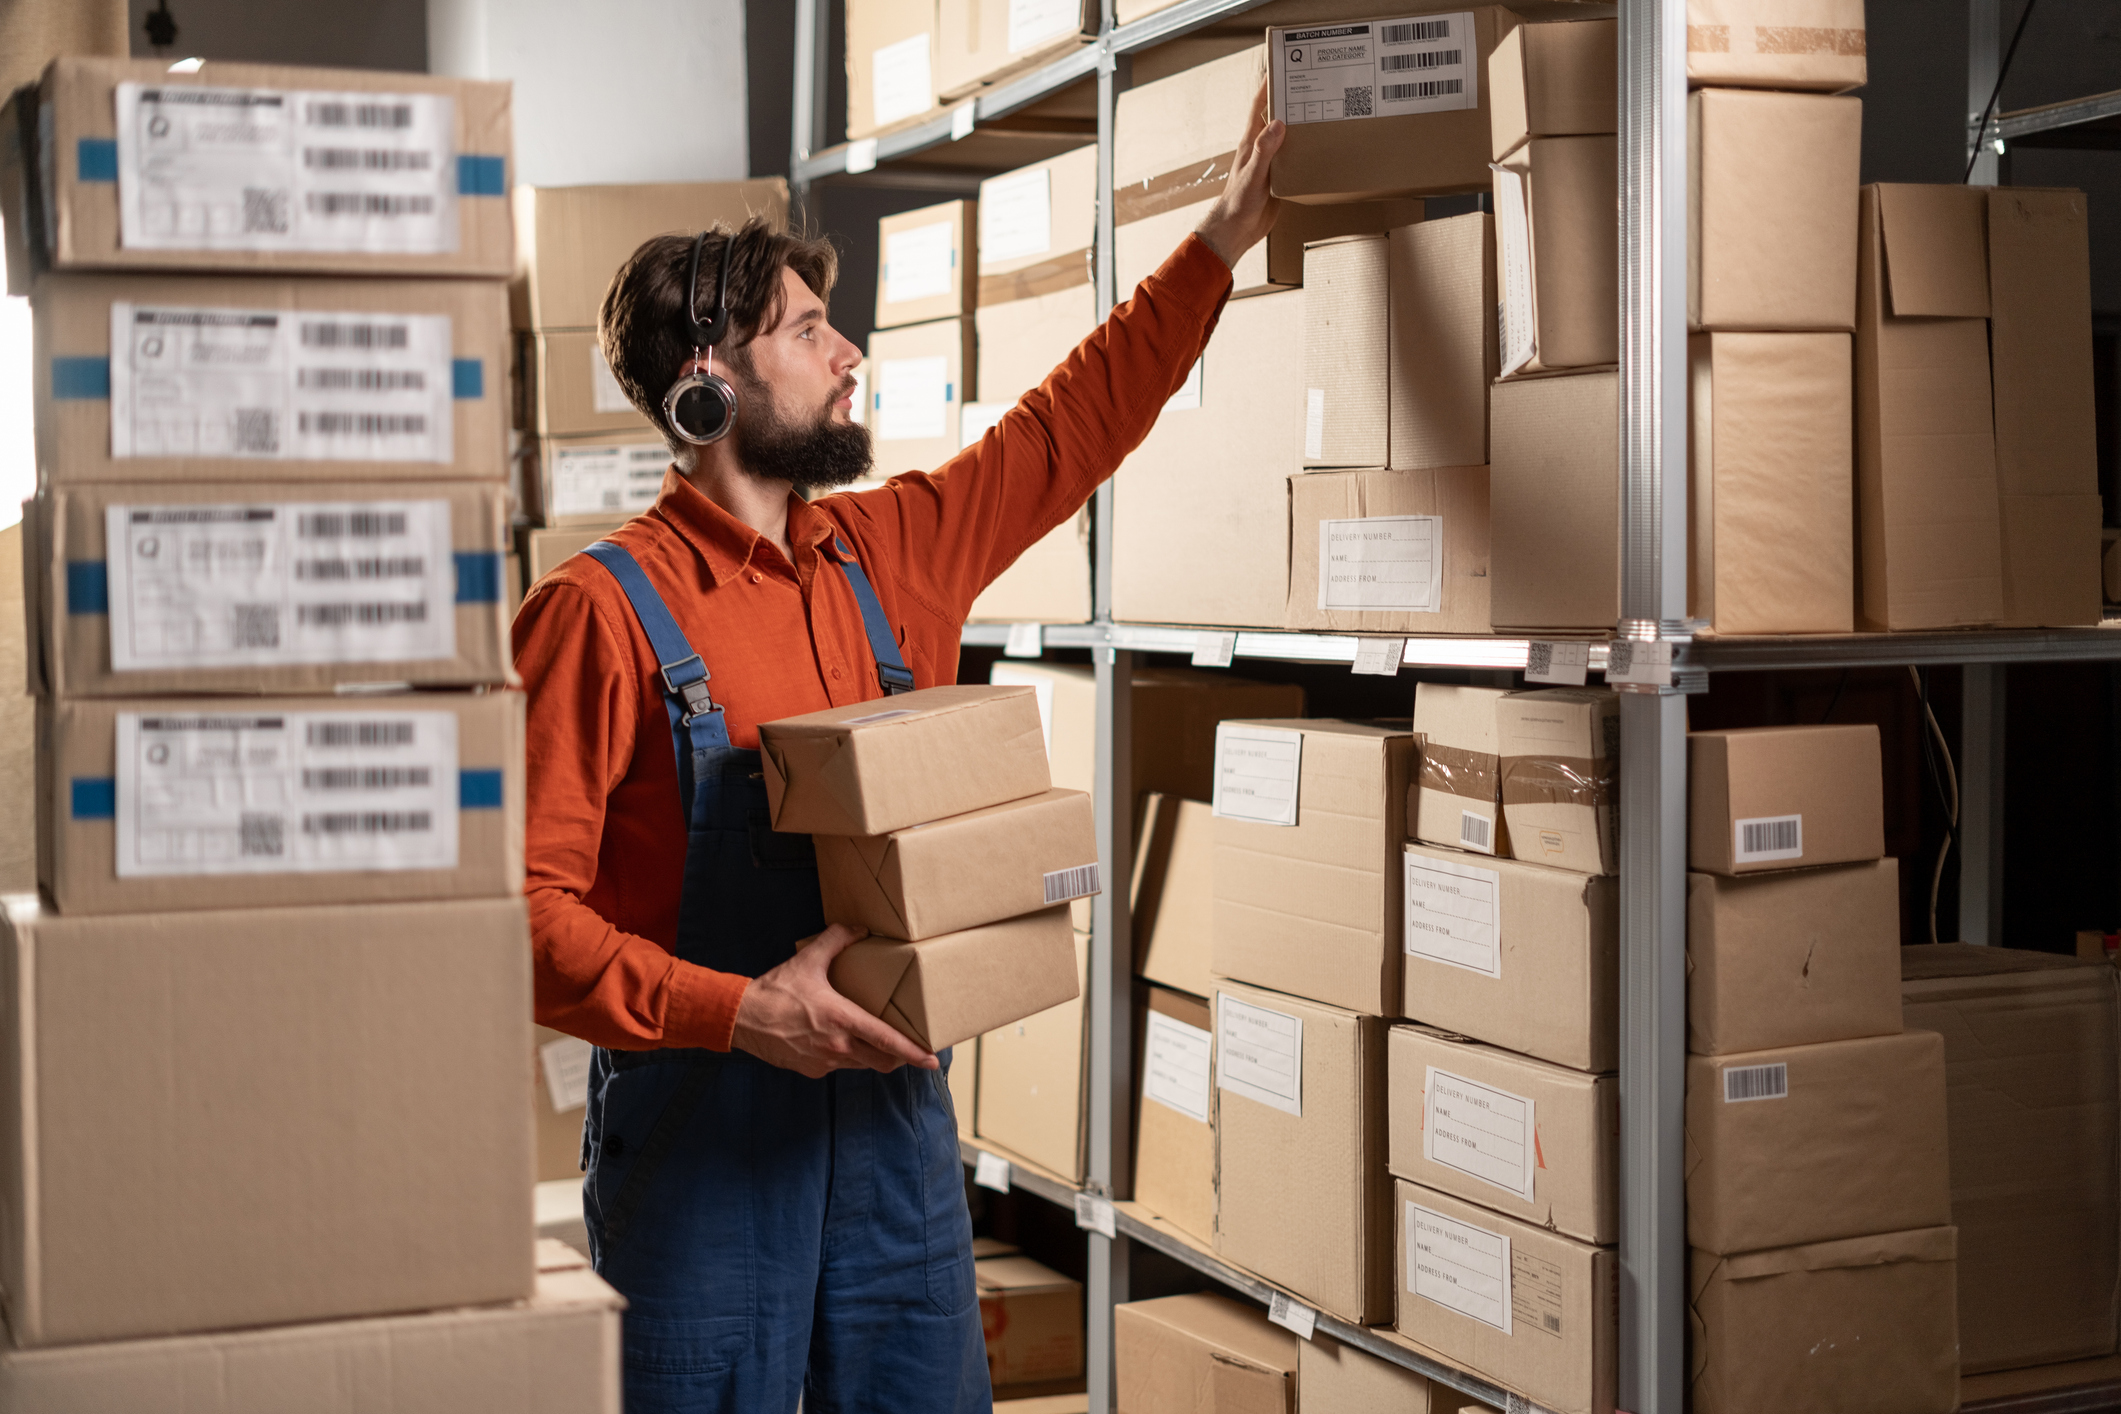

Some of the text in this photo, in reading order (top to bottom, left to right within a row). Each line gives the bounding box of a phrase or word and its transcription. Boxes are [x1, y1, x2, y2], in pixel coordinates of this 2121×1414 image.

[1296, 27, 1353, 39] BATCH NUMBER
[1290, 48, 1302, 62] Q
[1317, 46, 1347, 56] PRODUCT
[1332, 52, 1365, 60] CATEGORY
[1330, 532, 1392, 541] DELIVERY NUMBER
[1331, 554, 1347, 562] NAME
[1330, 574, 1377, 583] ADDRESS FROM
[1412, 877, 1460, 895] DELIVERY NUMBER
[1412, 899, 1426, 909] NAME
[1412, 920, 1450, 936] ADDRESS FROM
[1436, 1084, 1490, 1110] DELIVERY NUMBER
[1435, 1106, 1451, 1118] NAME
[1435, 1127, 1477, 1149] ADDRESS FROM
[1416, 1219, 1469, 1246] DELIVERY NUMBER
[1416, 1241, 1432, 1254] NAME
[1417, 1263, 1458, 1285] ADDRESS FROM
